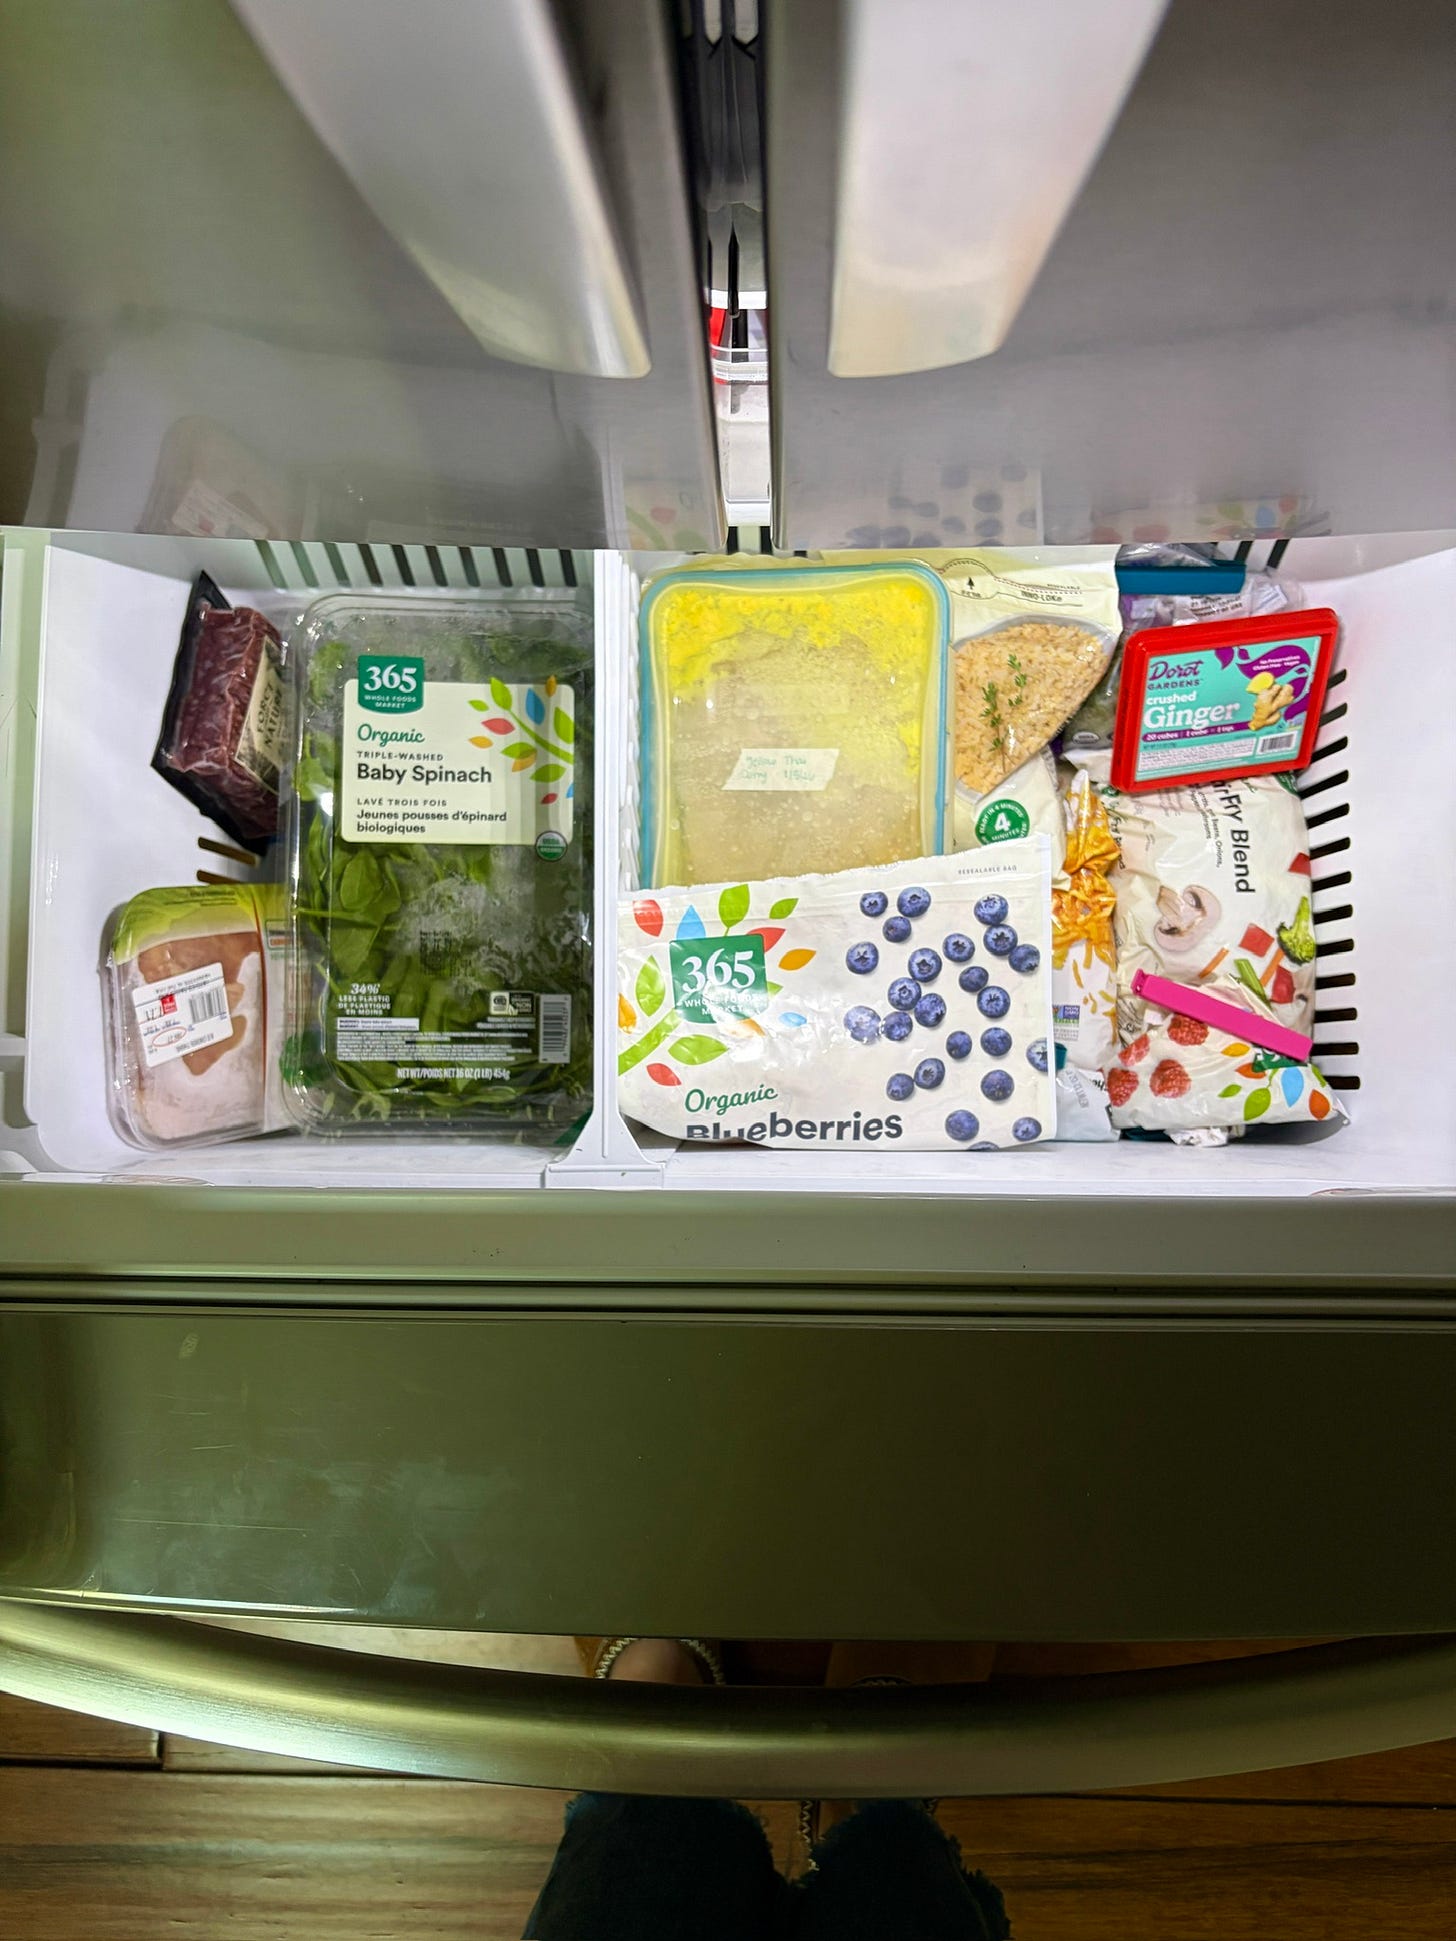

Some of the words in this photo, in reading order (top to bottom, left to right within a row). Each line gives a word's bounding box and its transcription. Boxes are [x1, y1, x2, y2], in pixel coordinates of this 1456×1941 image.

[364, 664, 417, 693] 365
[1149, 659, 1204, 681] Dorot
[1147, 679, 1200, 691] GARDENS
[1146, 690, 1197, 705] crushed
[1144, 702, 1240, 730] Ginger
[357, 723, 425, 747] Organic
[357, 751, 444, 761] TRIPLE-WASHED
[357, 763, 407, 785] Baby
[412, 765, 492, 786] Spinach
[357, 797, 383, 806] LAVÉ
[423, 799, 447, 807] FOIS
[357, 810, 399, 820] Jeunes
[402, 812, 449, 822] pousses
[994, 812, 1011, 832] 4
[357, 821, 426, 835] biologiques
[992, 828, 1020, 840] MINUTES
[1230, 829, 1255, 893] Blend
[682, 948, 756, 994] 365
[684, 994, 723, 1008] WHOE
[702, 1004, 744, 1015] MRKET
[397, 1067, 410, 1079] NET
[685, 1083, 778, 1115] Organic
[686, 1111, 903, 1142] Blueberries
